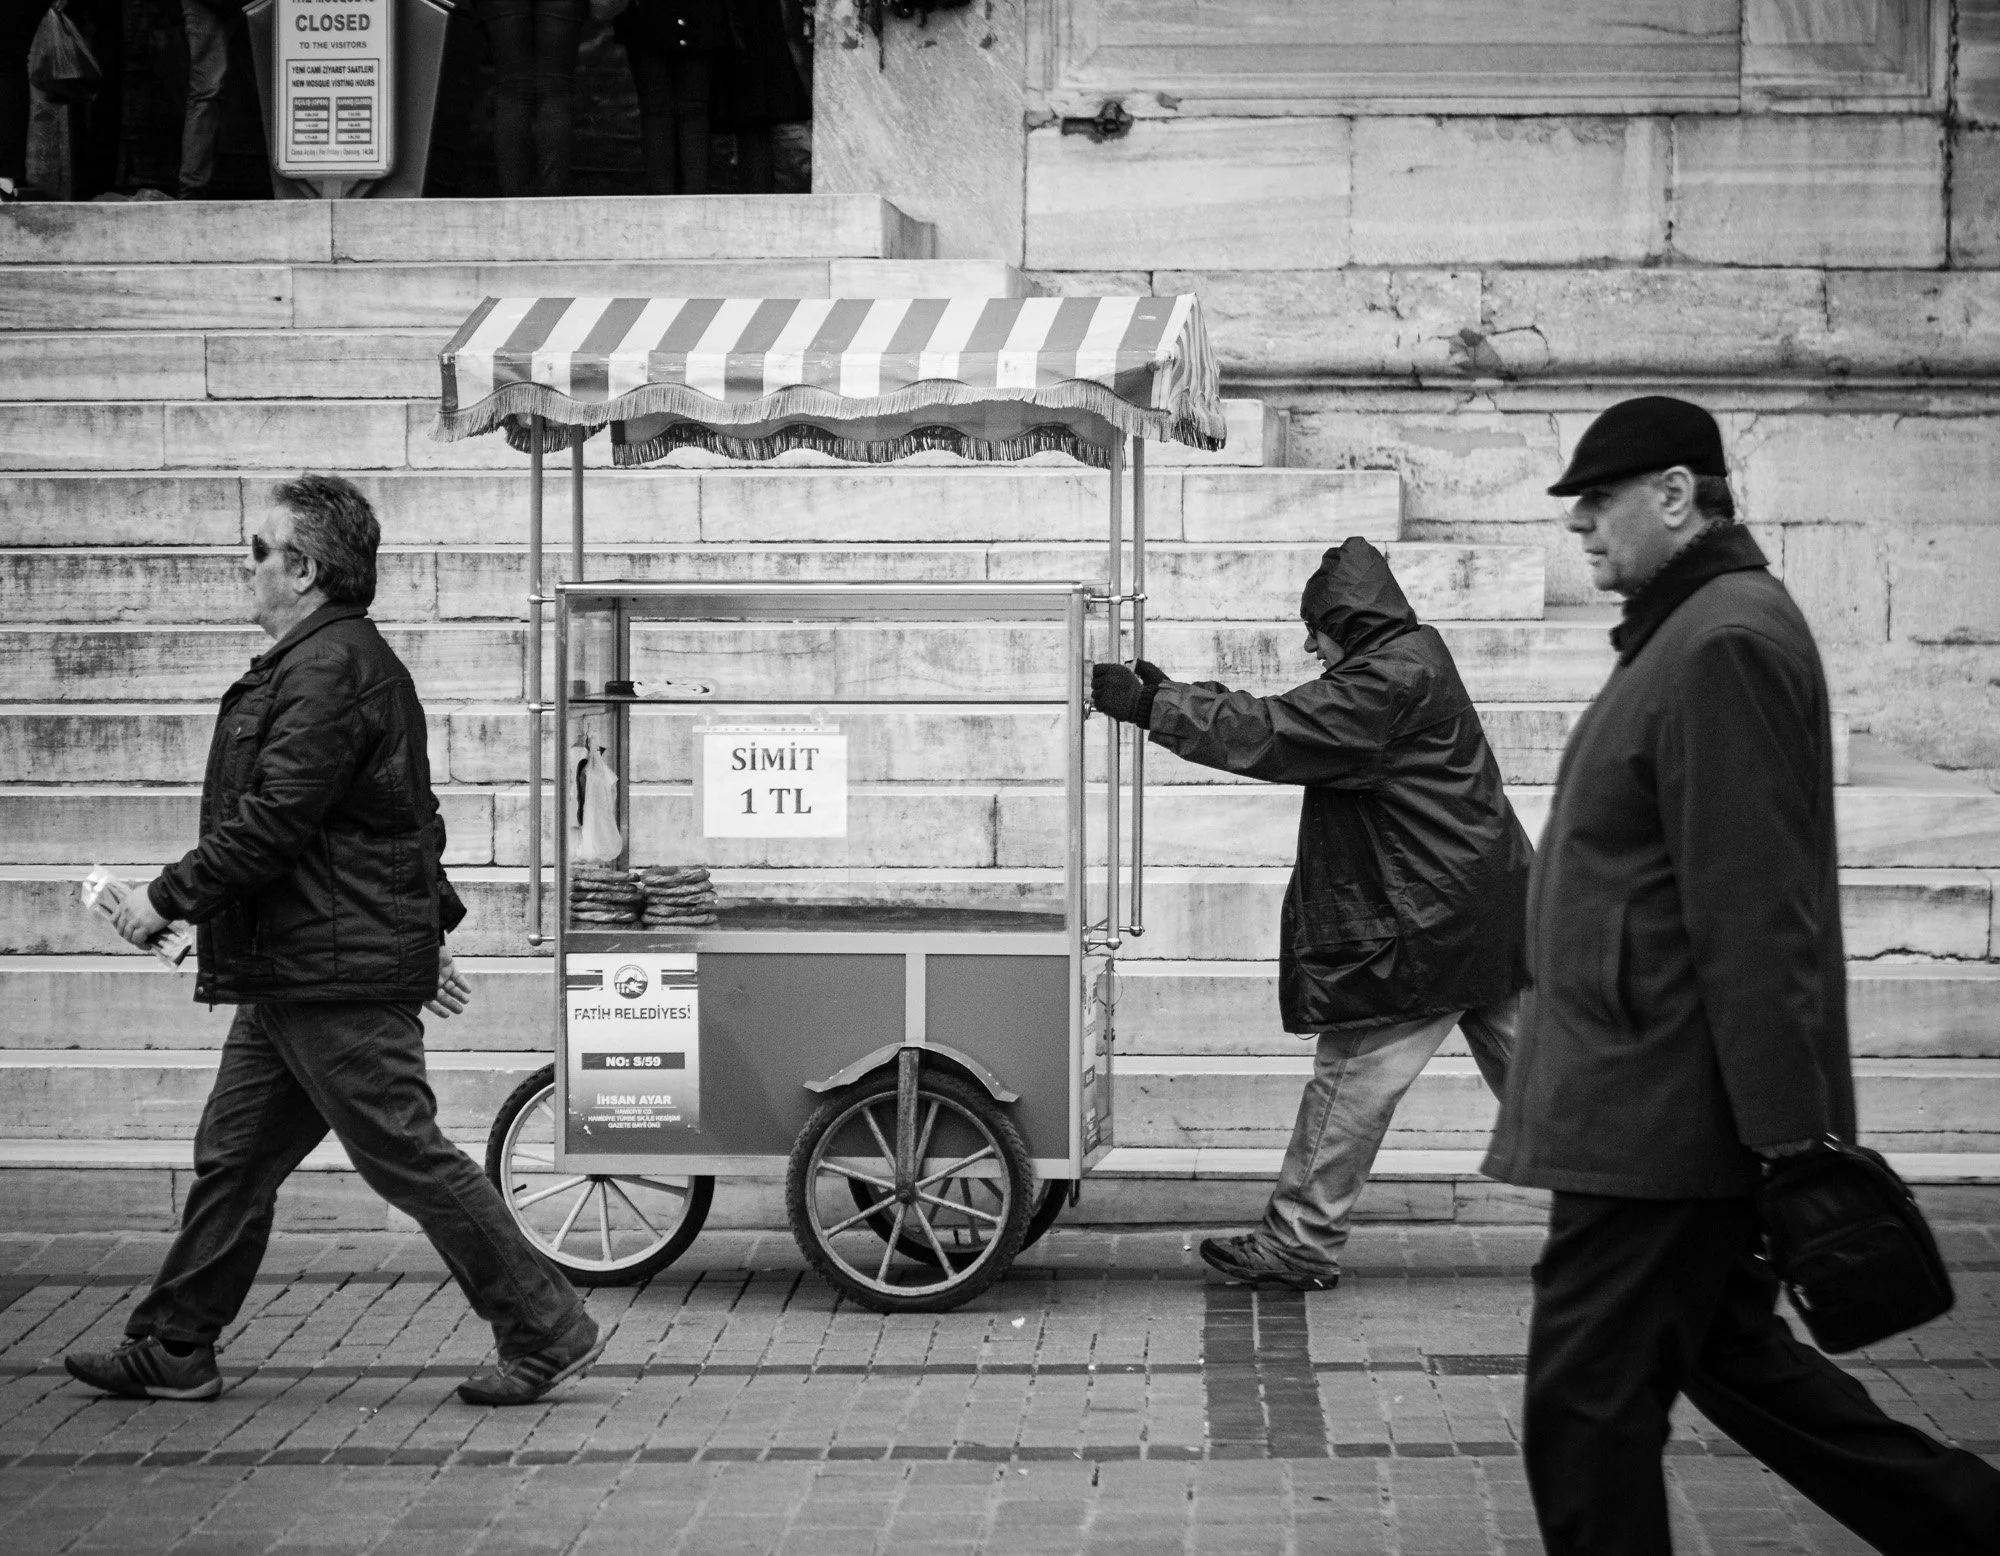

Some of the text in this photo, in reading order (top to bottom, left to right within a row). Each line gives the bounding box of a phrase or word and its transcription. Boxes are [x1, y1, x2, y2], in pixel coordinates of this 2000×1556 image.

[295, 14, 371, 32] CLOSED
[299, 41, 367, 49] TO THE VISITORS
[291, 80, 305, 88] NEW
[306, 80, 330, 88] MOSQUE
[355, 79, 375, 87] HOURS
[732, 742, 819, 771] SİMİT
[741, 788, 812, 814] 1 TL
[574, 1004, 691, 1020] FATİH BELEDİYESİ
[605, 1056, 661, 1067] NO: S/59
[597, 1093, 672, 1105] İHSAN AYAR
